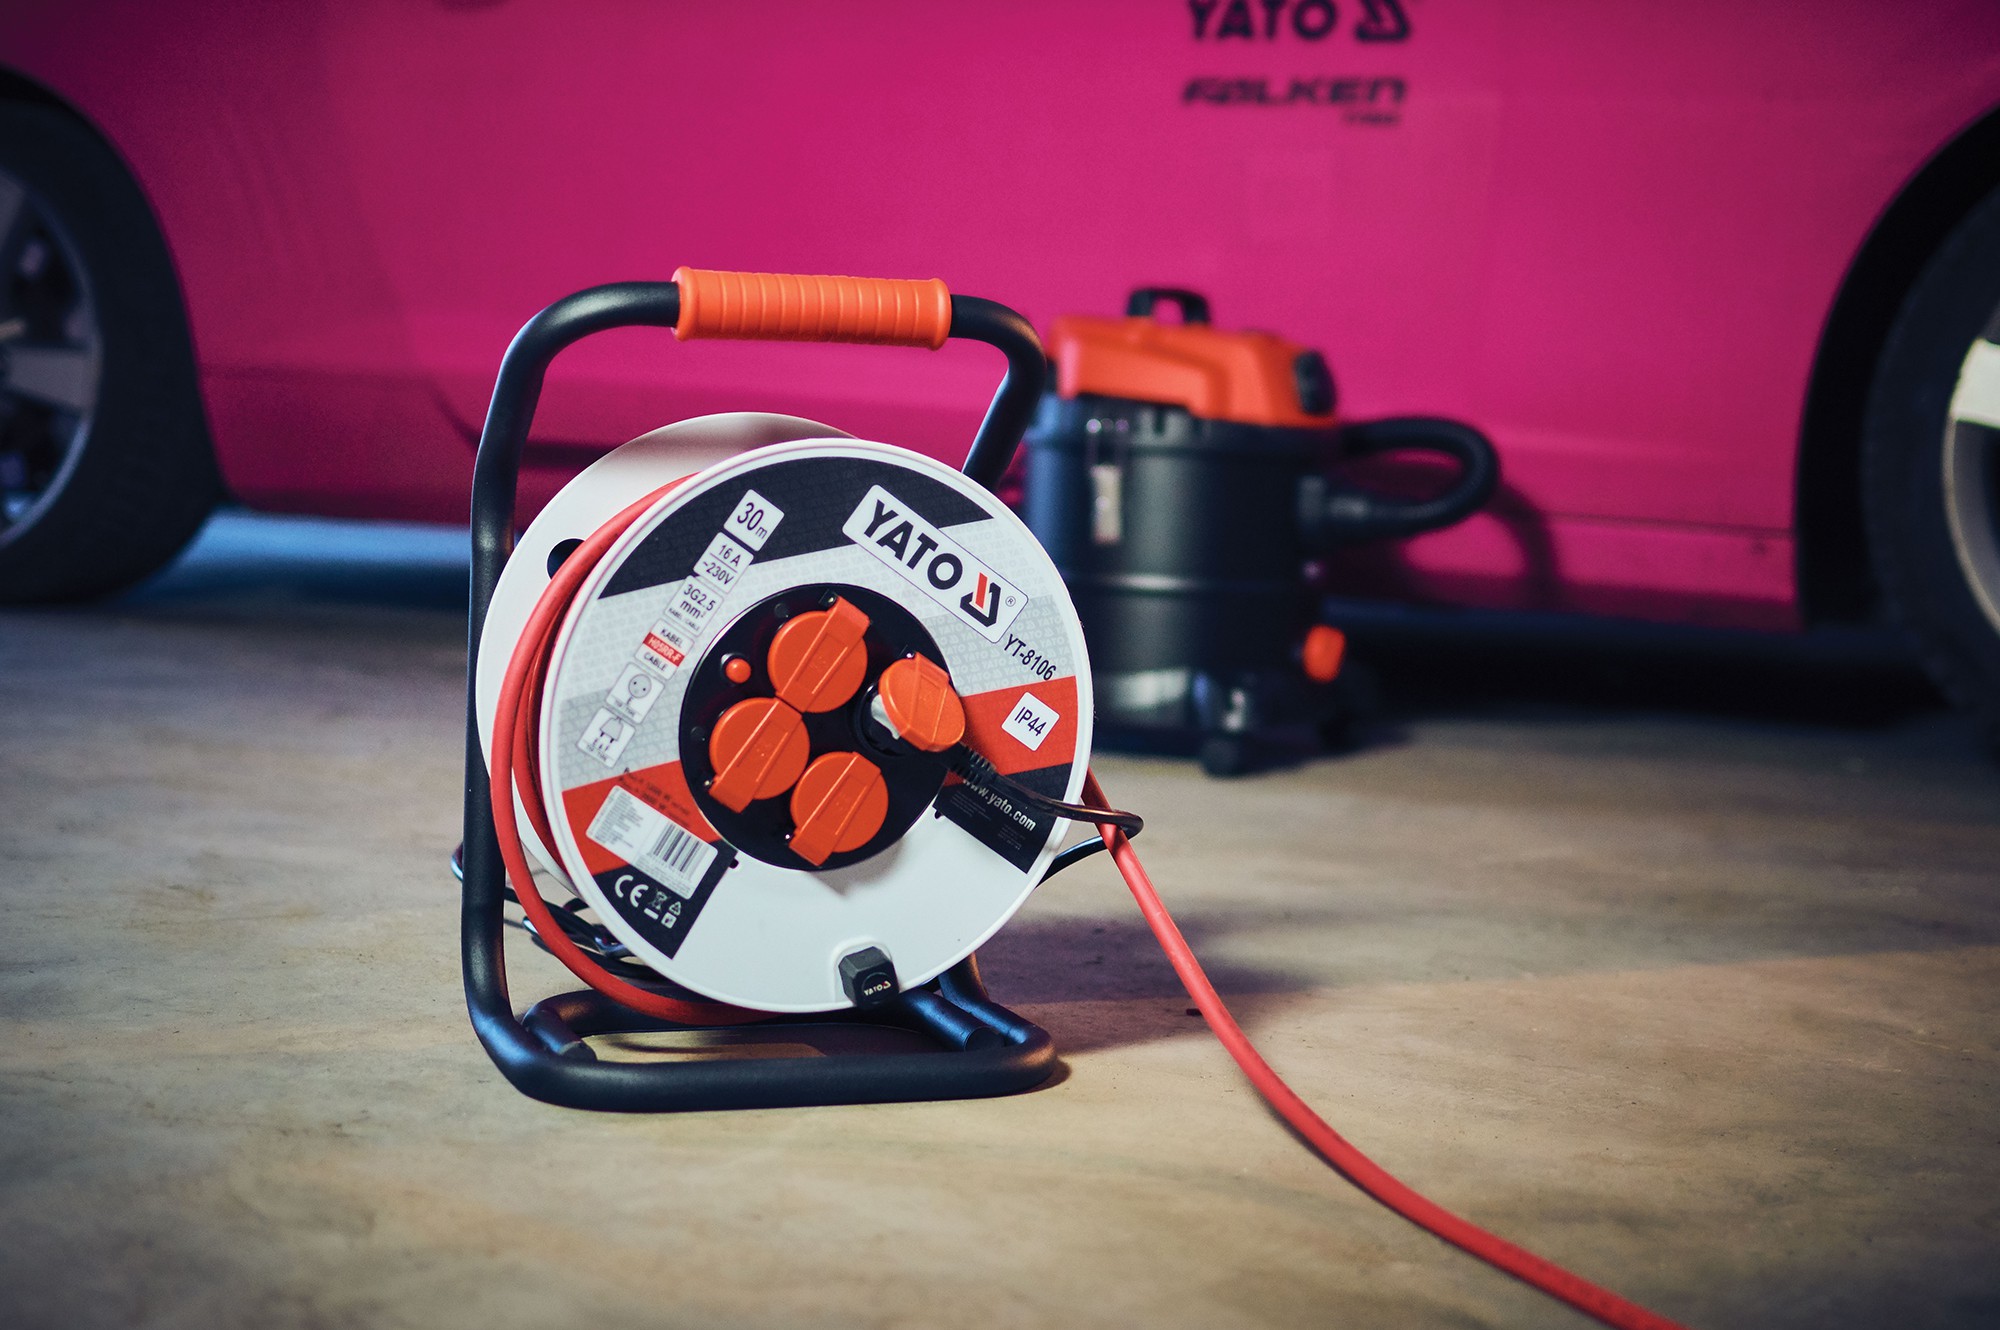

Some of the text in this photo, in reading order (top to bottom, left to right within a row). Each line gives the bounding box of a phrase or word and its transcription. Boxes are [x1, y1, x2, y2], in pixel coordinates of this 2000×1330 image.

[1187, 0, 1338, 40] YATO
[719, 544, 741, 567] 16 A
[863, 499, 963, 590] YATO
[683, 584, 716, 611] 3G2.5
[661, 628, 684, 648] KABEL
[643, 652, 668, 671] CABLE
[1004, 633, 1057, 681] YT-8106
[1014, 706, 1047, 736] IP44
